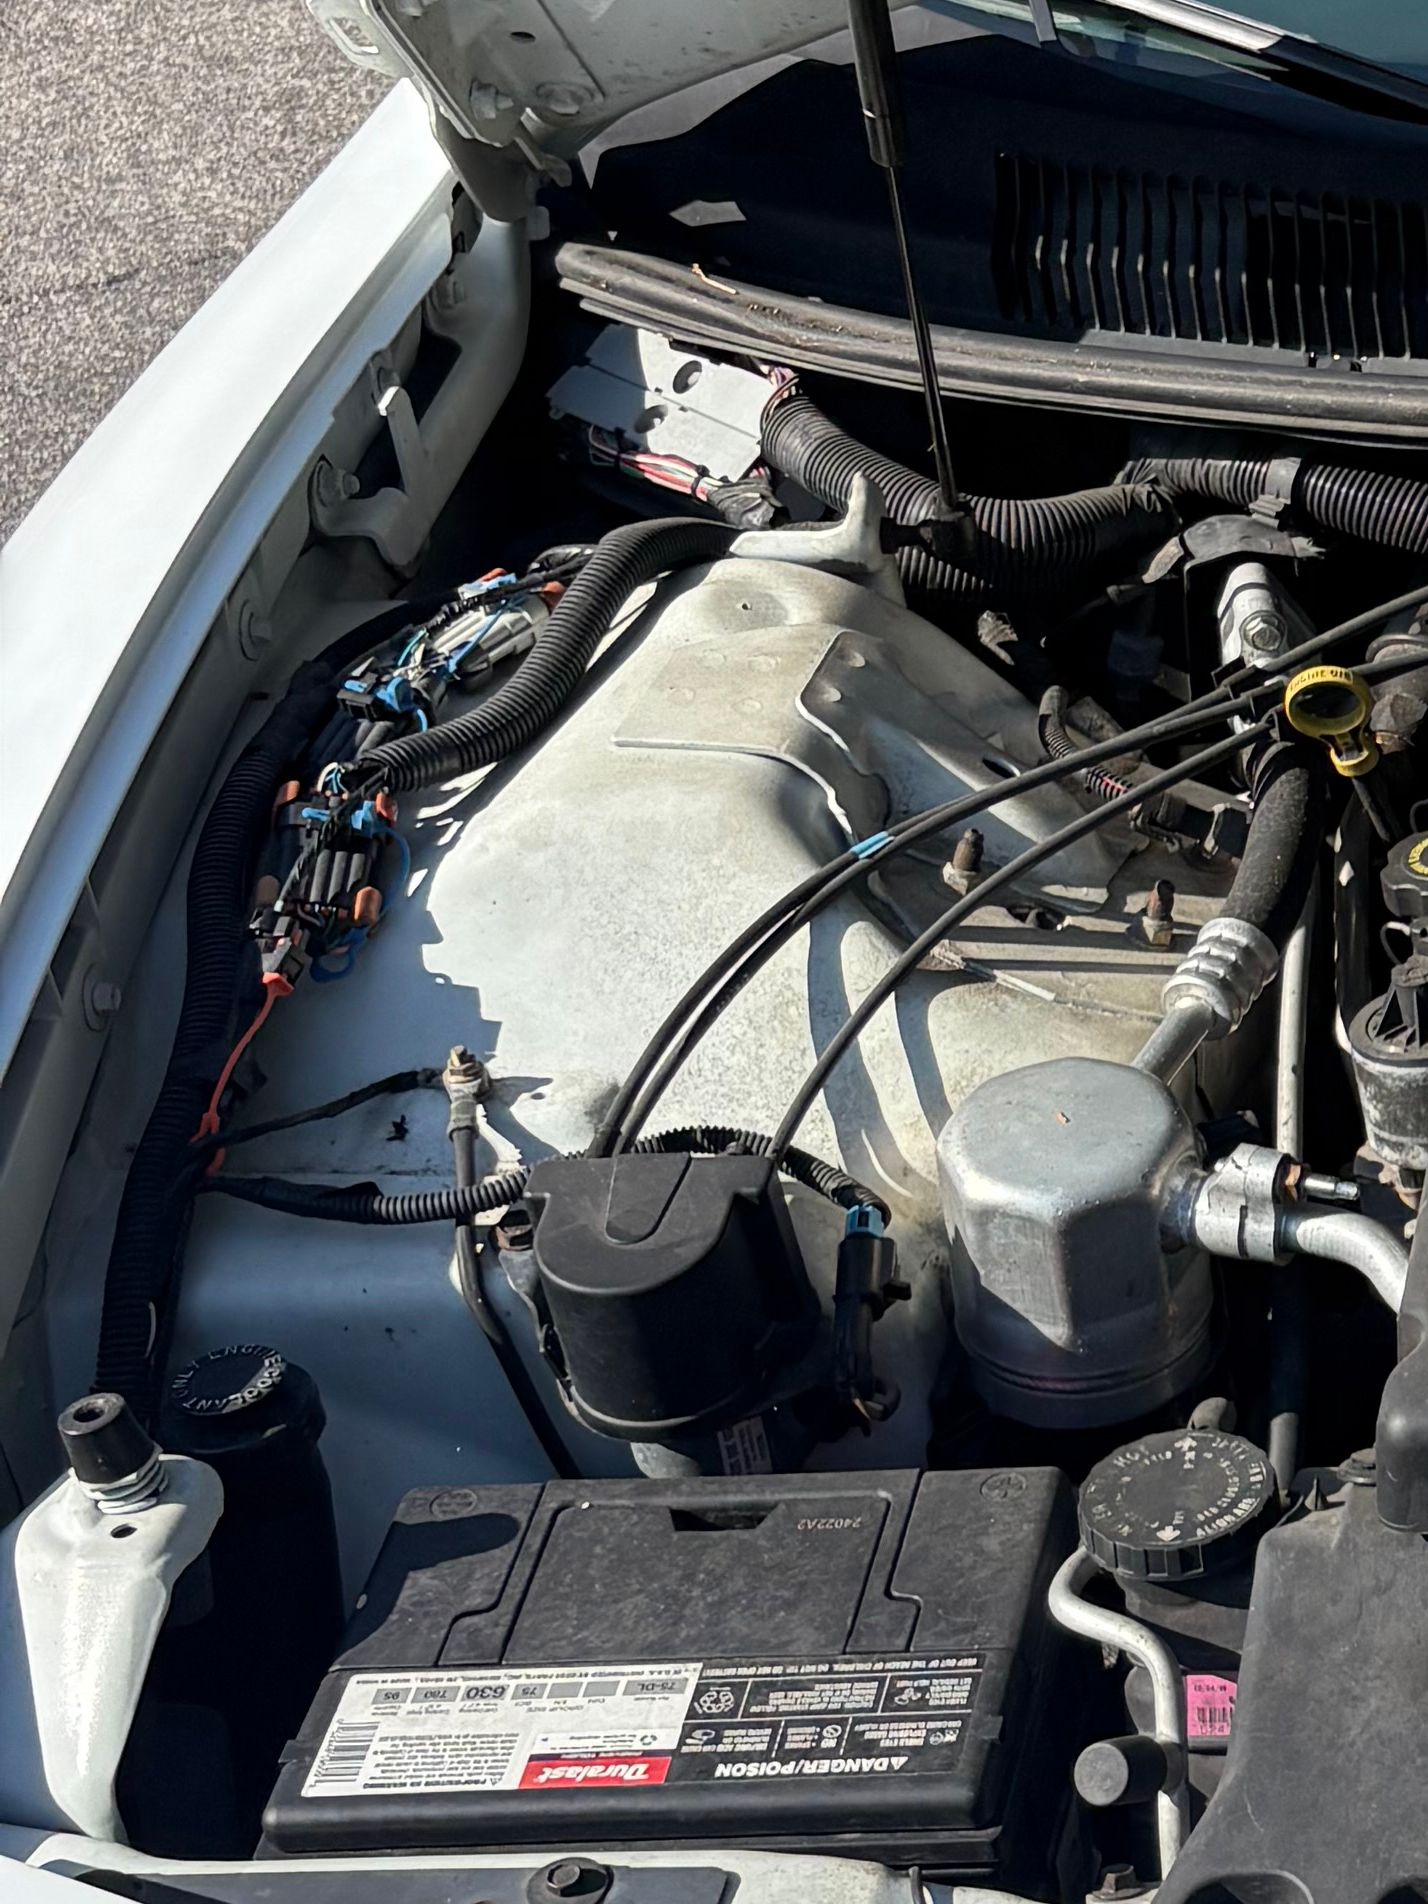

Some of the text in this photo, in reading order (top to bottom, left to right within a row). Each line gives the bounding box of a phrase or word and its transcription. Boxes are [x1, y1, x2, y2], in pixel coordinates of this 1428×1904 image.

[797, 1516, 863, 1531] 24022A2
[383, 1691, 402, 1701] 95
[465, 1685, 507, 1701] 630
[522, 1687, 539, 1696] 75
[536, 1763, 650, 1783] Duralast
[713, 1756, 891, 1778] DANGER/POISON
